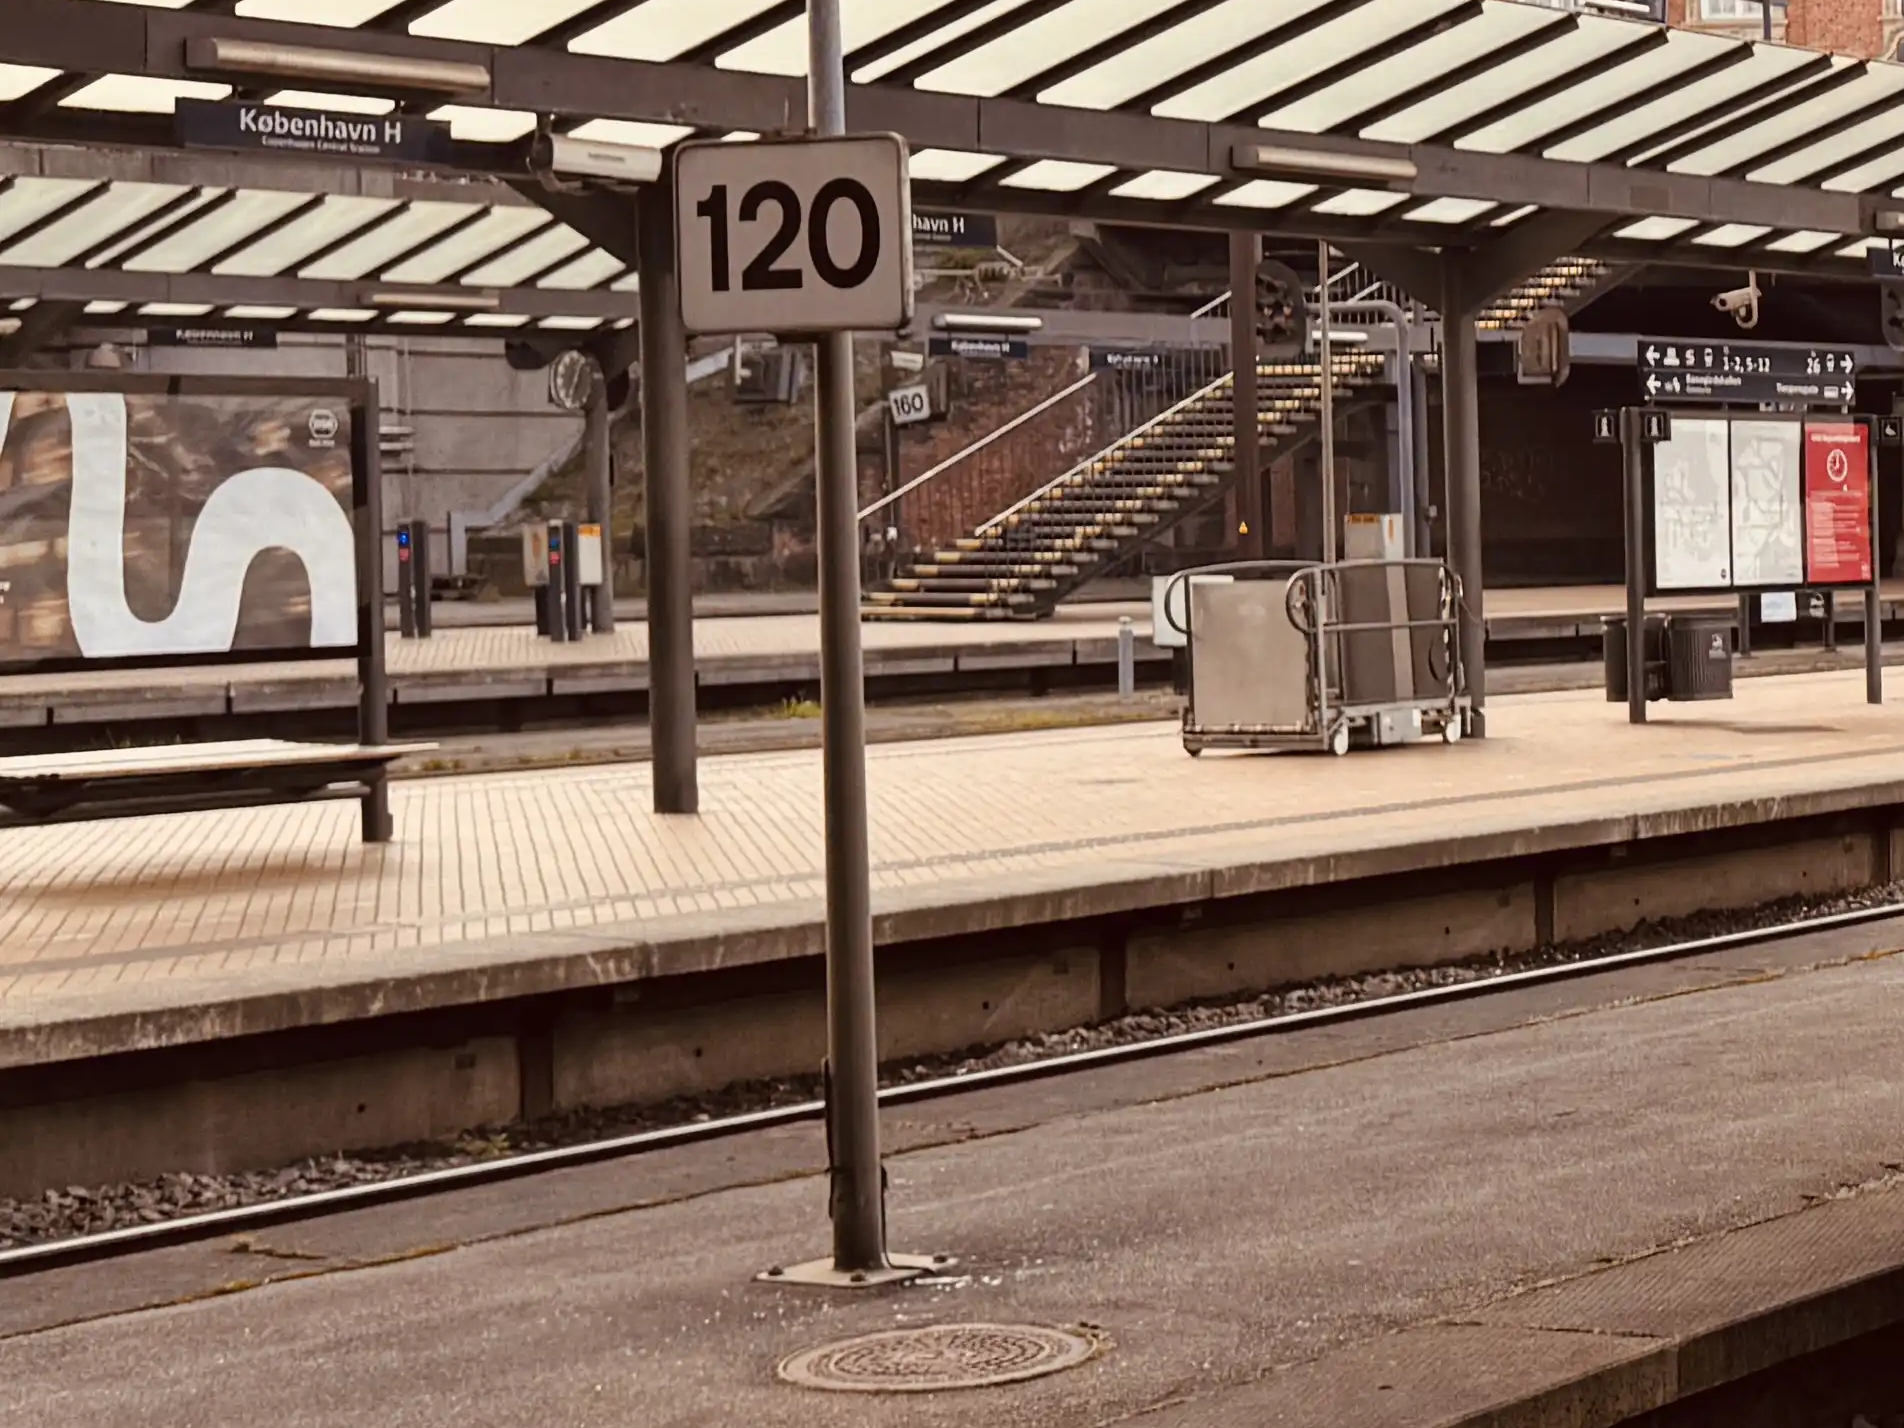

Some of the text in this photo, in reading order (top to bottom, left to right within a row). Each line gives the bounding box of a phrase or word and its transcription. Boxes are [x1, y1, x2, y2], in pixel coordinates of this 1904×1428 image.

[240, 108, 402, 144] København H
[697, 177, 880, 292] 120
